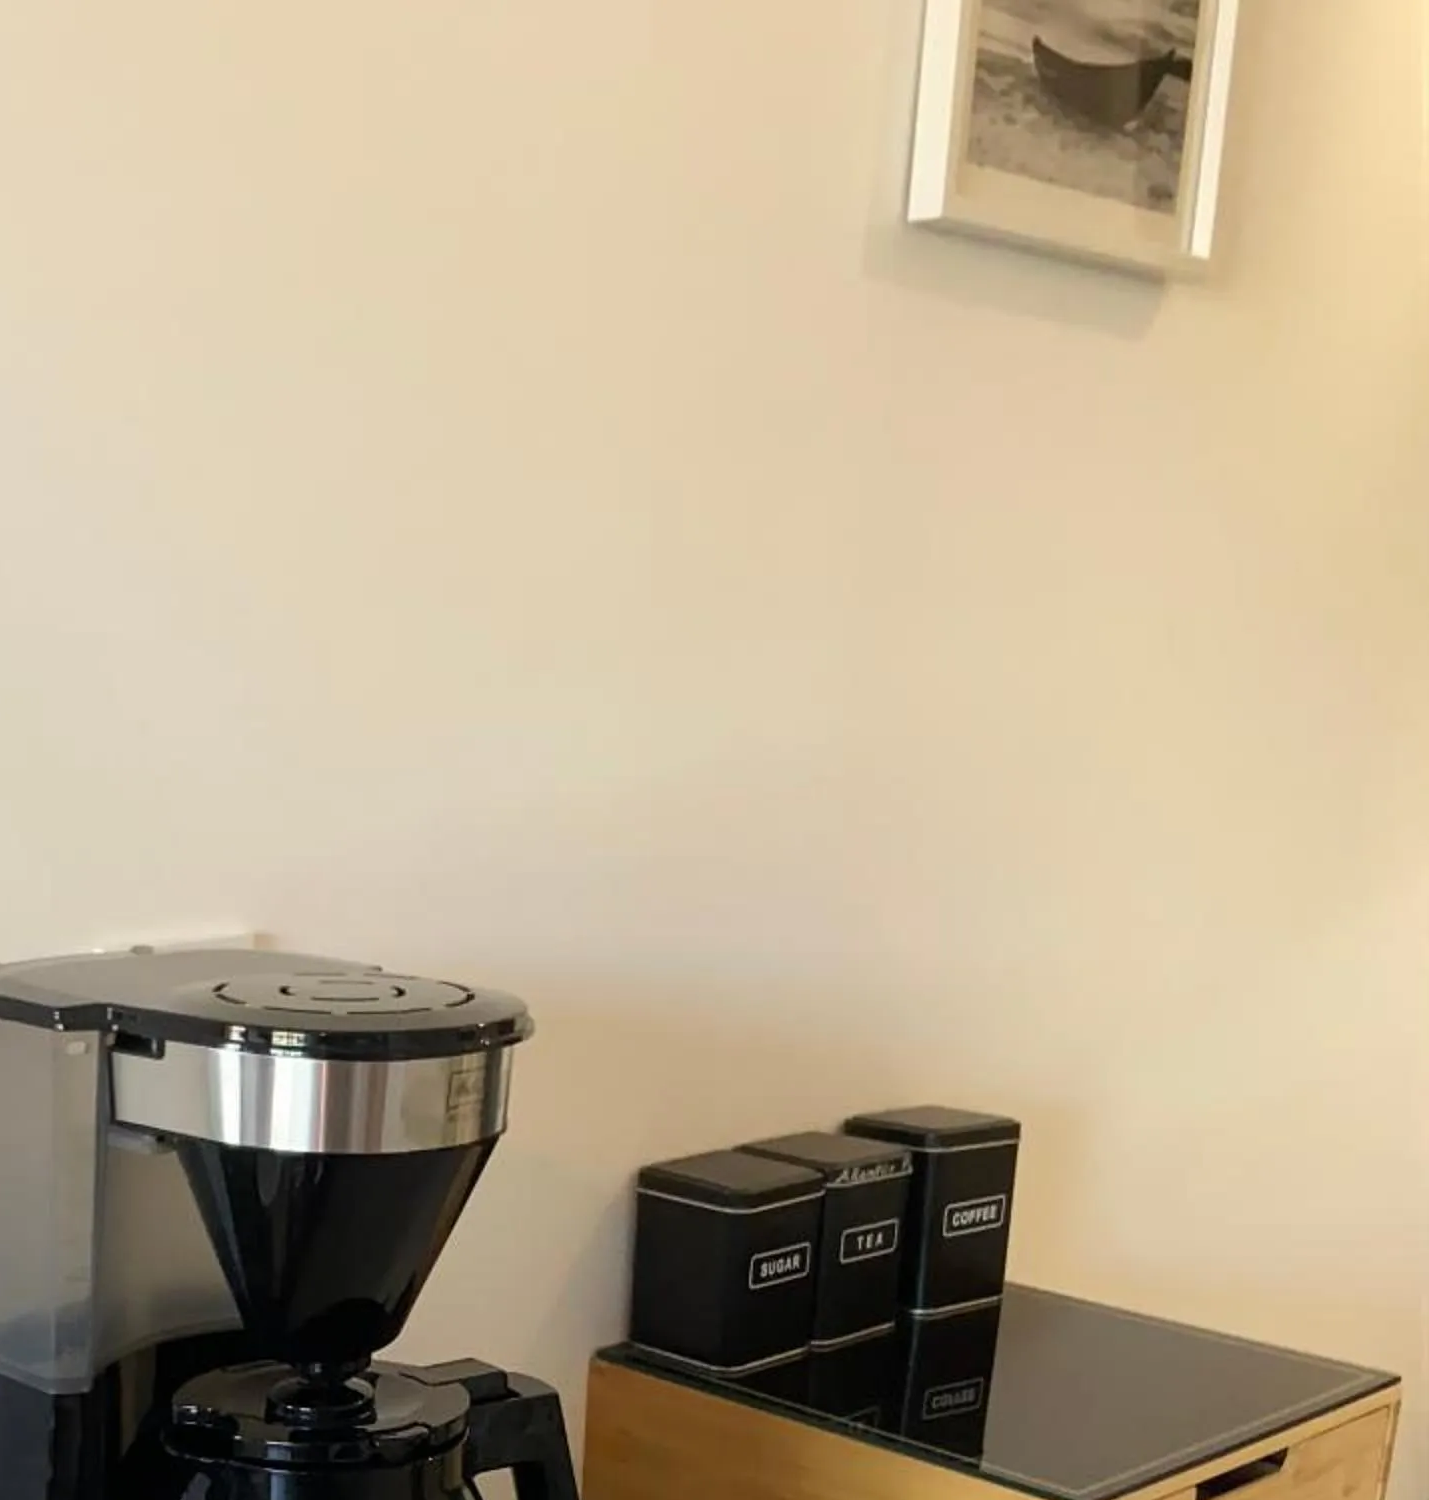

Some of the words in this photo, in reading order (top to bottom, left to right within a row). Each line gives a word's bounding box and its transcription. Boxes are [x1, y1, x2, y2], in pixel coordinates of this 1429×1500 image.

[952, 1207, 998, 1226] COFFEE
[856, 1232, 884, 1251] TEA
[760, 1255, 801, 1278] SUGAR
